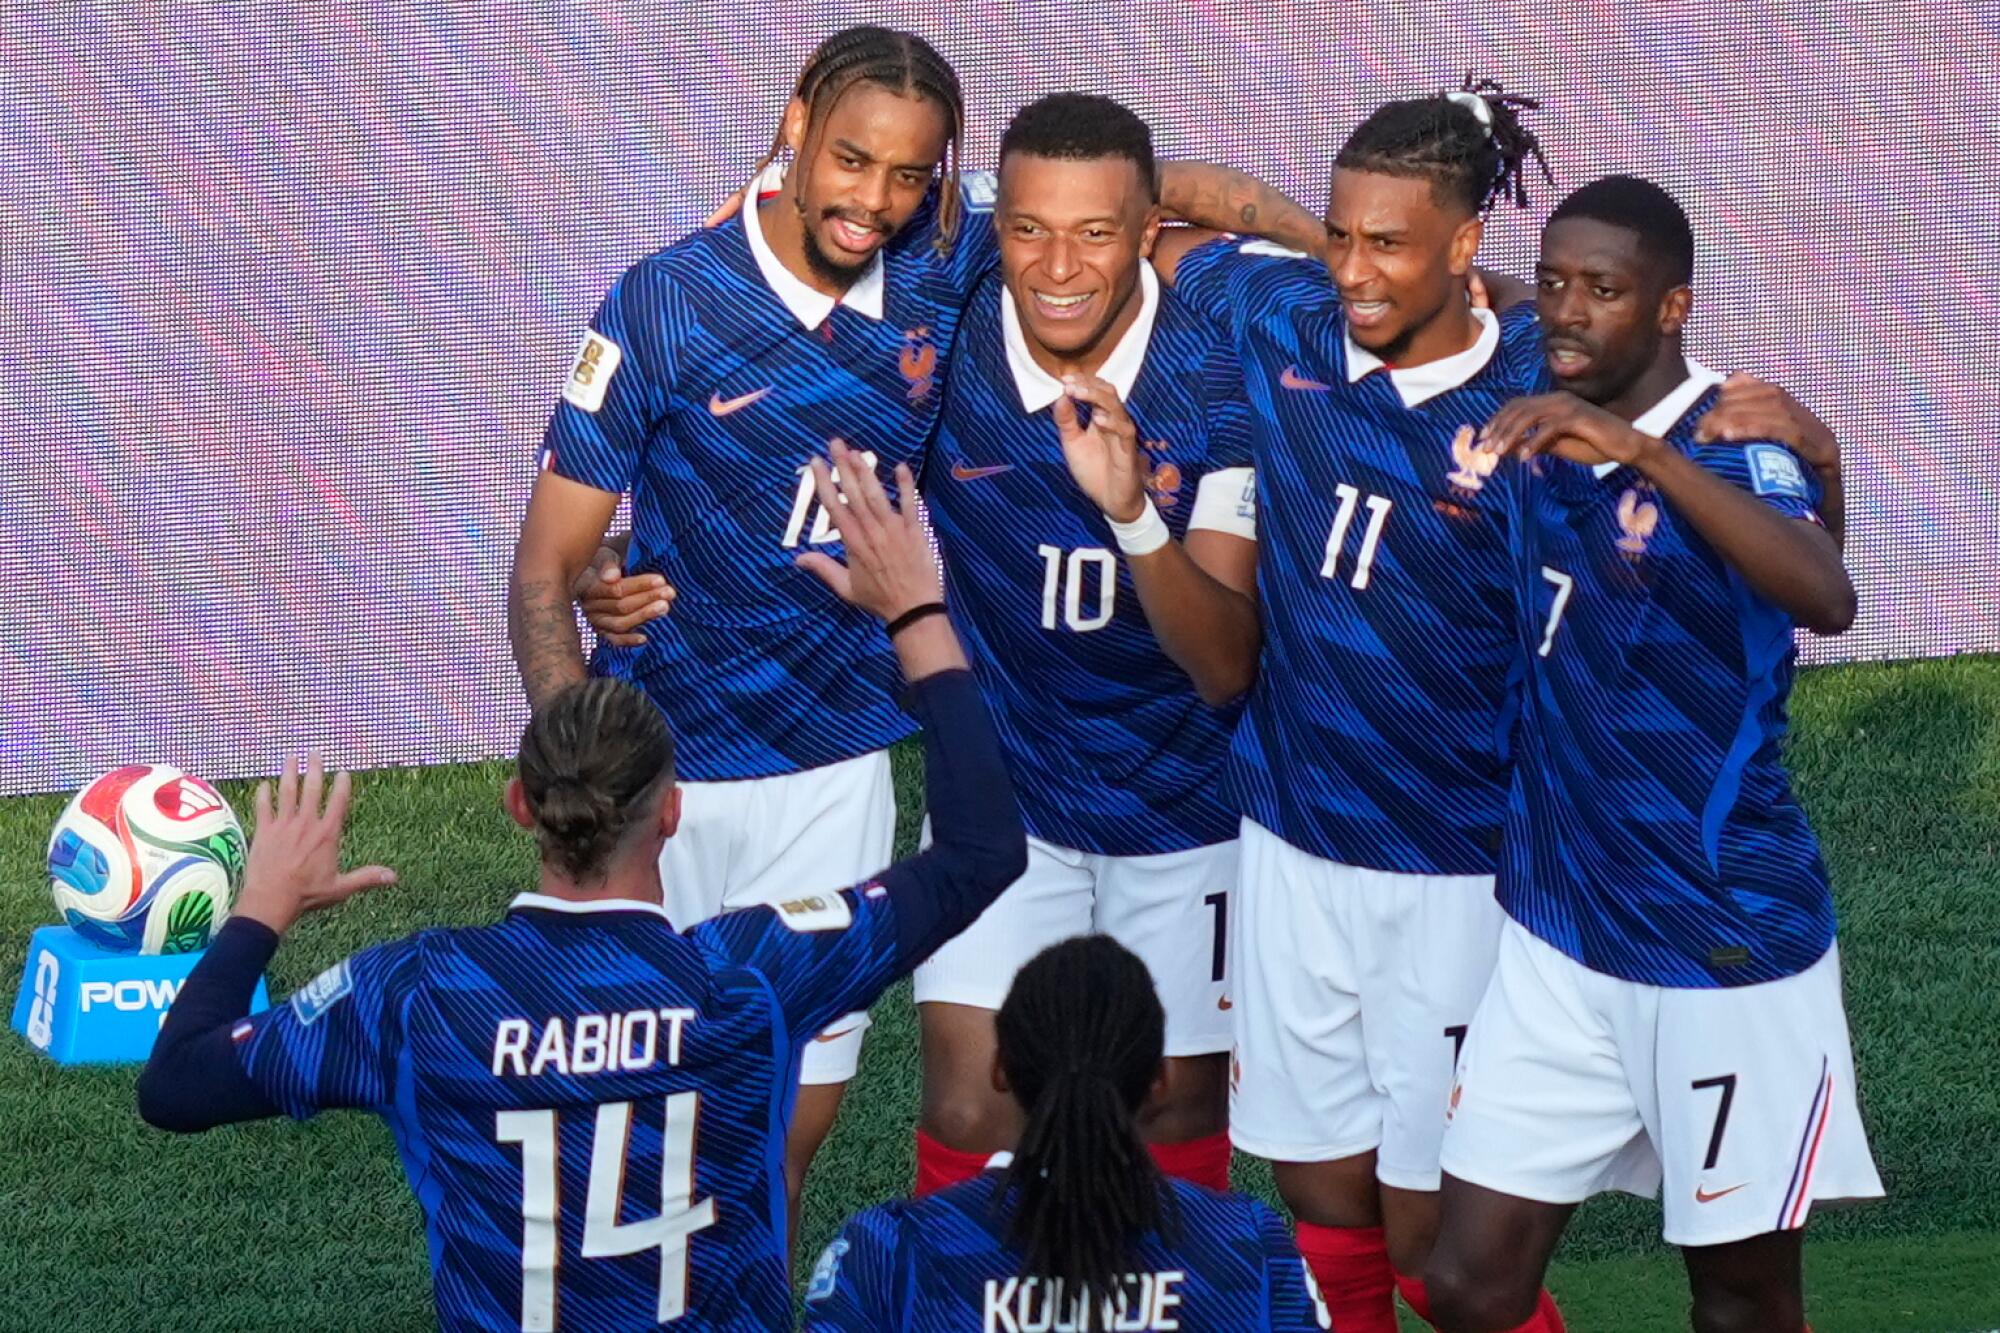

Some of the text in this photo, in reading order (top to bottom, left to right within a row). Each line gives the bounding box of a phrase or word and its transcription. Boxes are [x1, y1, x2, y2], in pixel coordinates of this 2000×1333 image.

[1320, 483, 1392, 589] 11
[1038, 543, 1116, 632] 10
[1538, 565, 1572, 657] 7
[1204, 891, 1228, 982] 1
[80, 978, 188, 1013] POW
[492, 1008, 695, 1076] RABIOT
[1691, 1073, 1737, 1170] 7
[496, 1090, 719, 1333] 14
